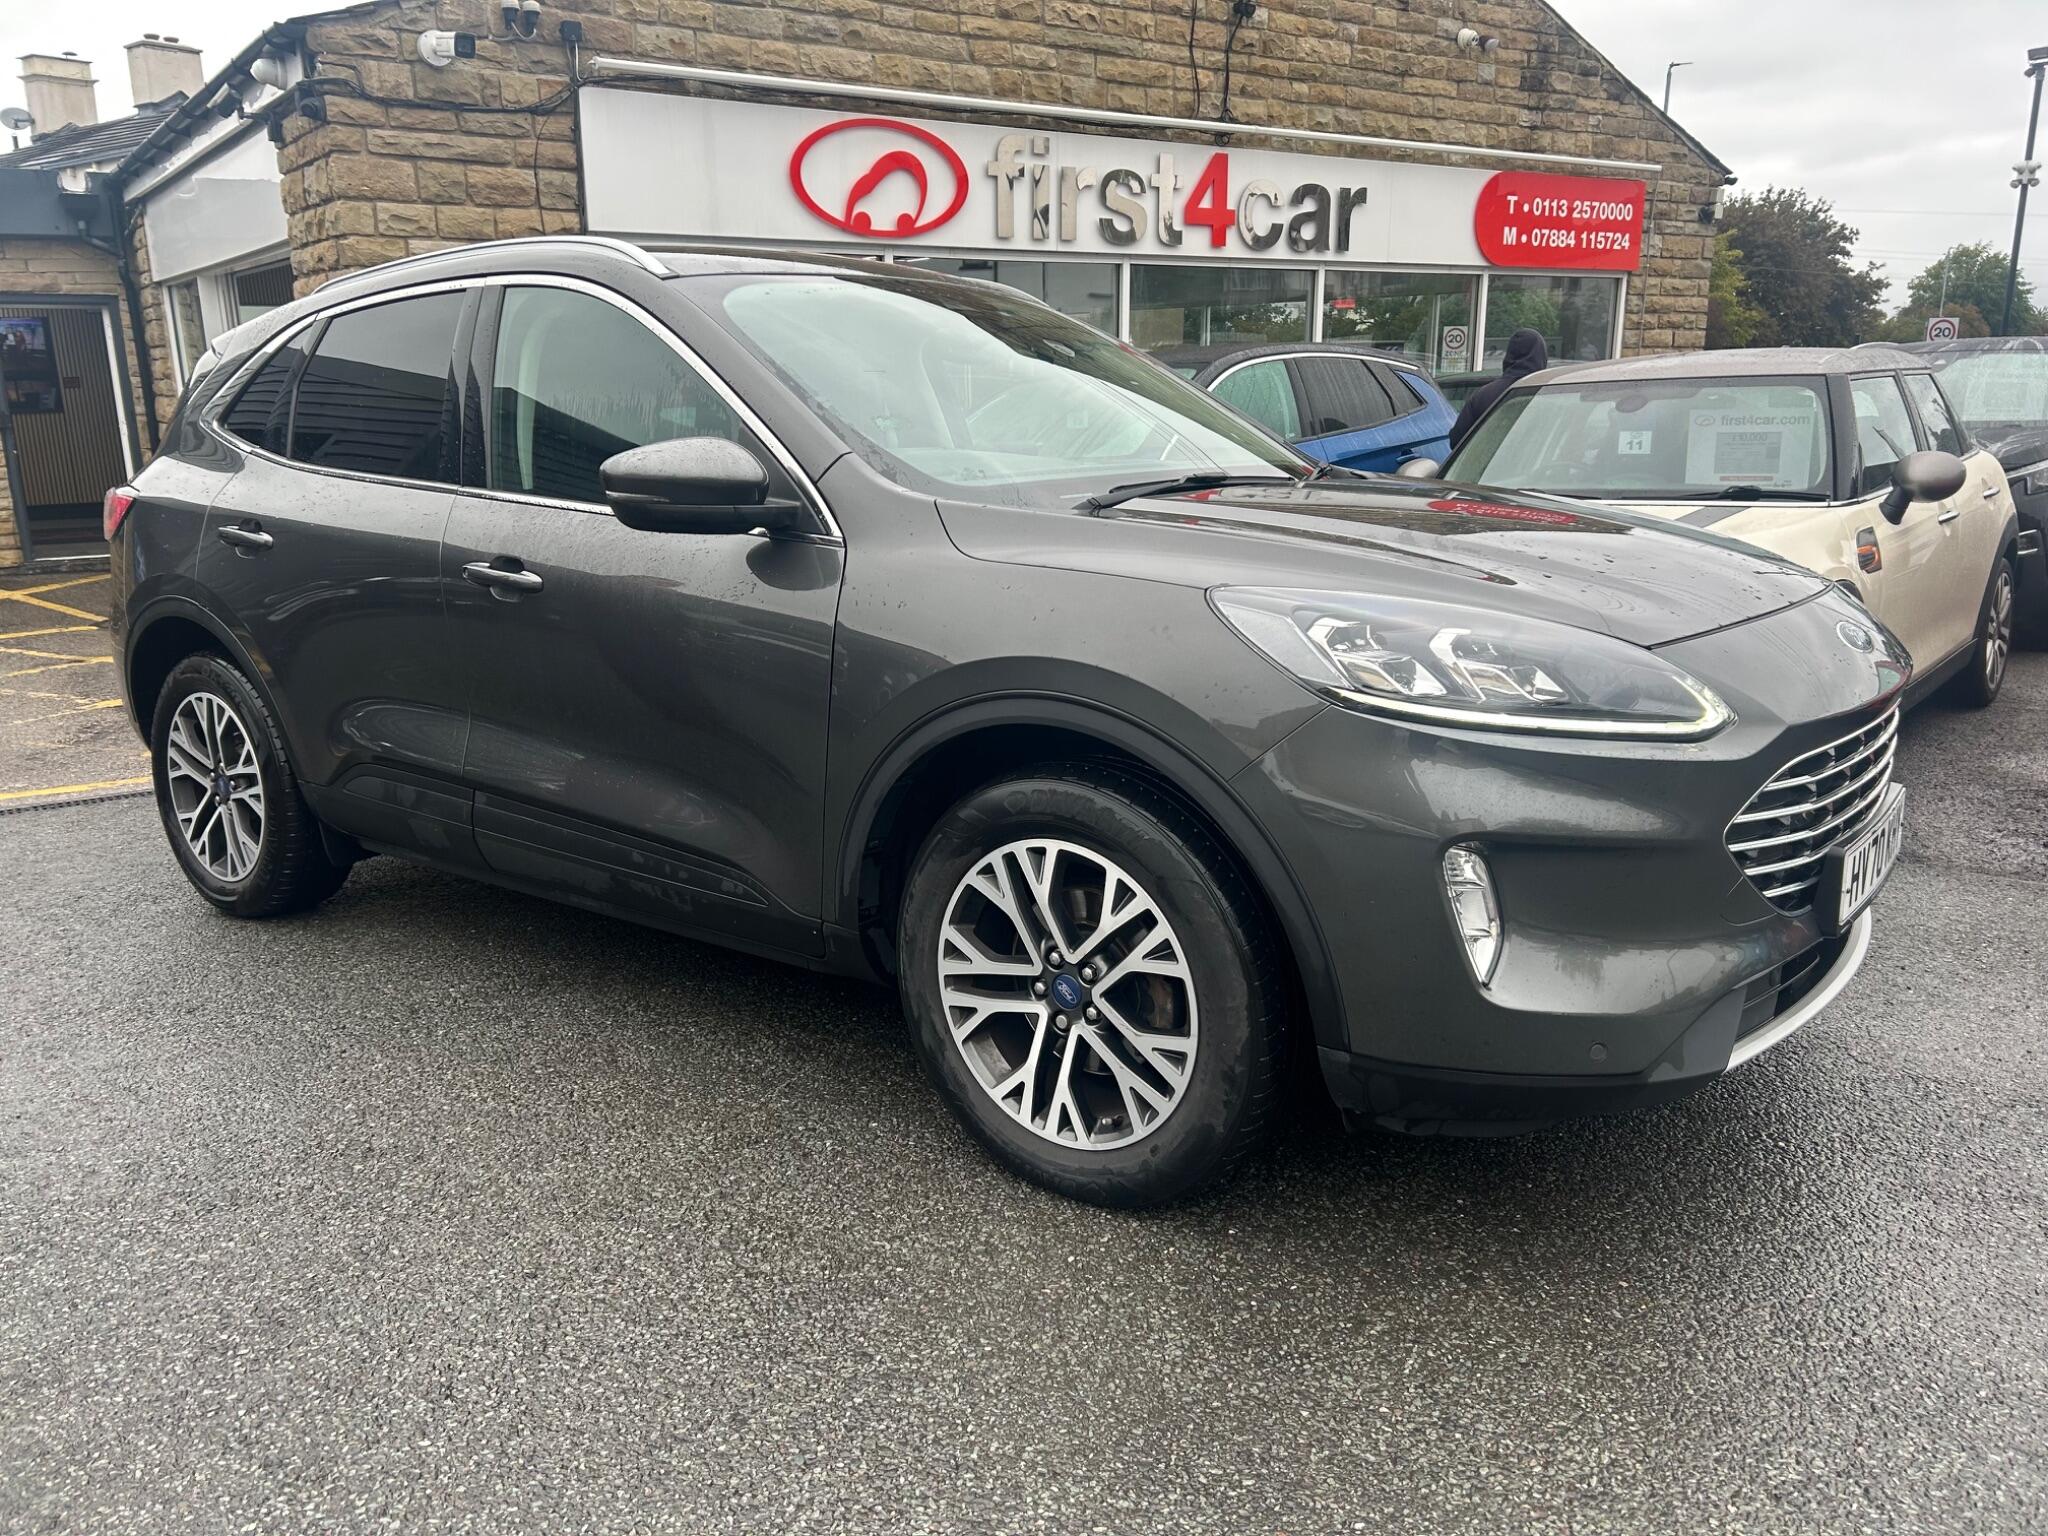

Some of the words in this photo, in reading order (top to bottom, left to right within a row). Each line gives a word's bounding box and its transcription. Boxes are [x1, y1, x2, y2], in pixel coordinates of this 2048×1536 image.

[987, 134, 1368, 253] first4car
[1507, 195, 1519, 215] T
[1533, 198, 1568, 218] 0113
[1572, 200, 1633, 221] 2570000
[1503, 226, 1517, 246] M
[1531, 228, 1576, 248] 07884
[1581, 231, 1630, 250] 115724
[1448, 334, 1463, 343] 20
[1933, 327, 1951, 338] 20
[1721, 414, 1811, 426] first4car.com
[1626, 439, 1643, 451] 11
[1849, 828, 1886, 908] HV70
